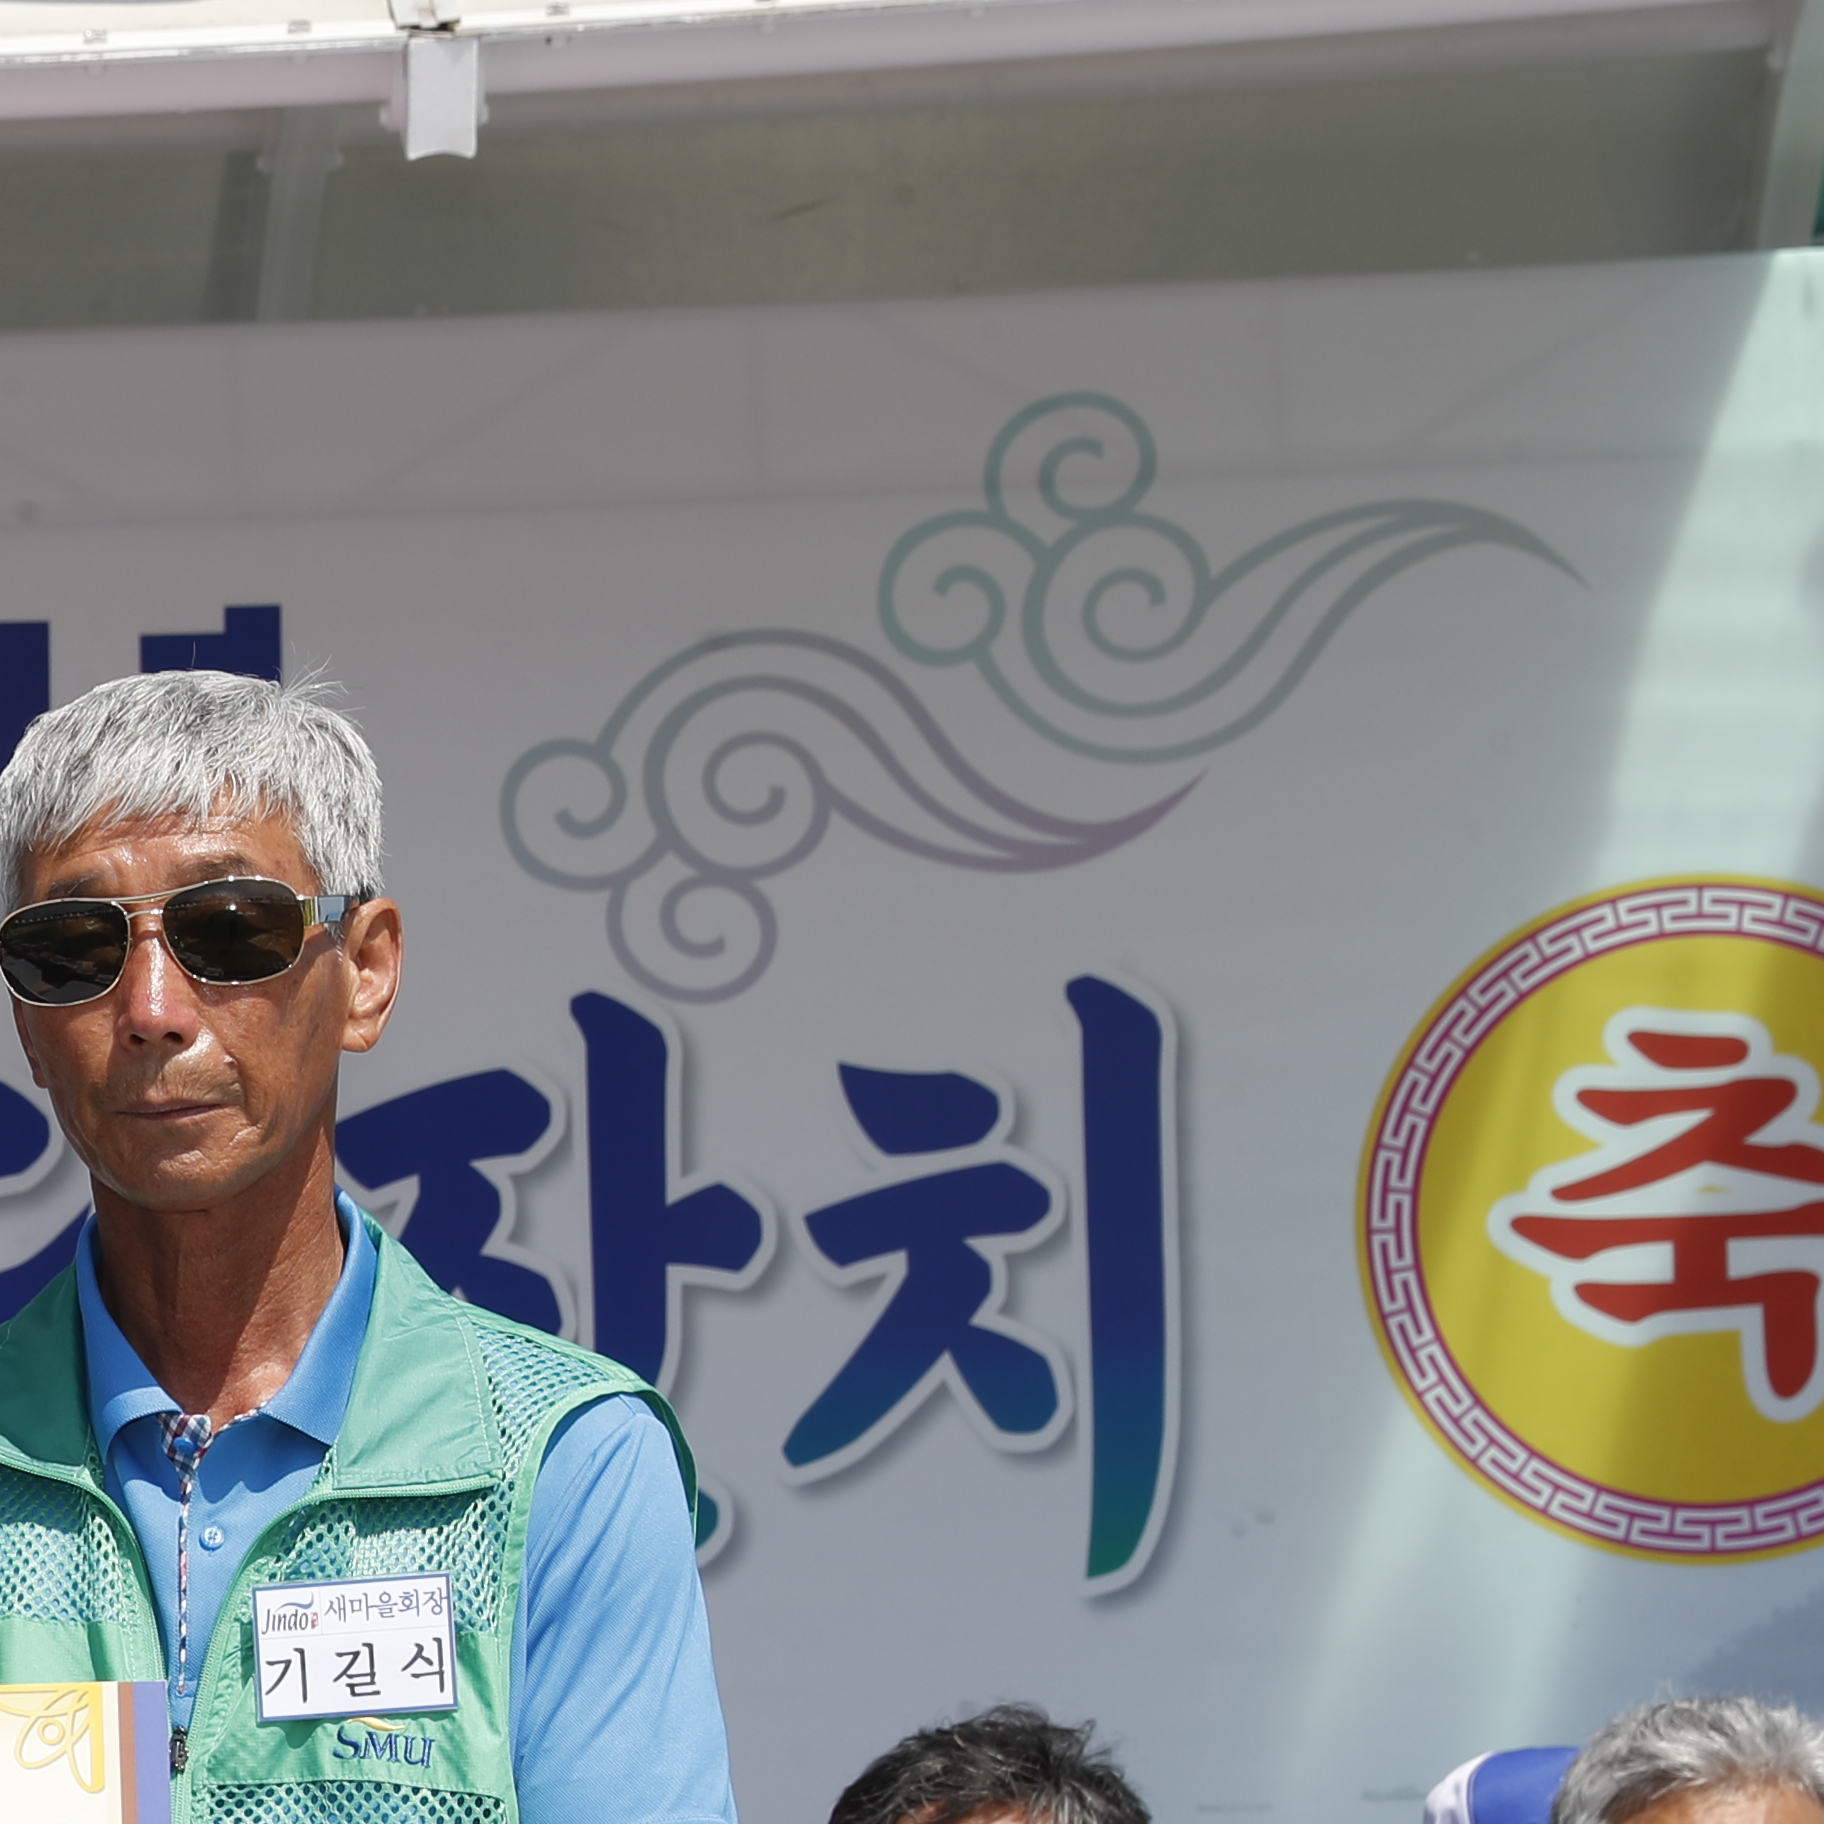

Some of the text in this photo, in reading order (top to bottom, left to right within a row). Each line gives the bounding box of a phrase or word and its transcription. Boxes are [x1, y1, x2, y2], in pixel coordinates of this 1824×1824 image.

[261, 1607, 309, 1635] Jindo
[323, 1586, 448, 1624] 새마을회장
[331, 1724, 436, 1769] SMU
